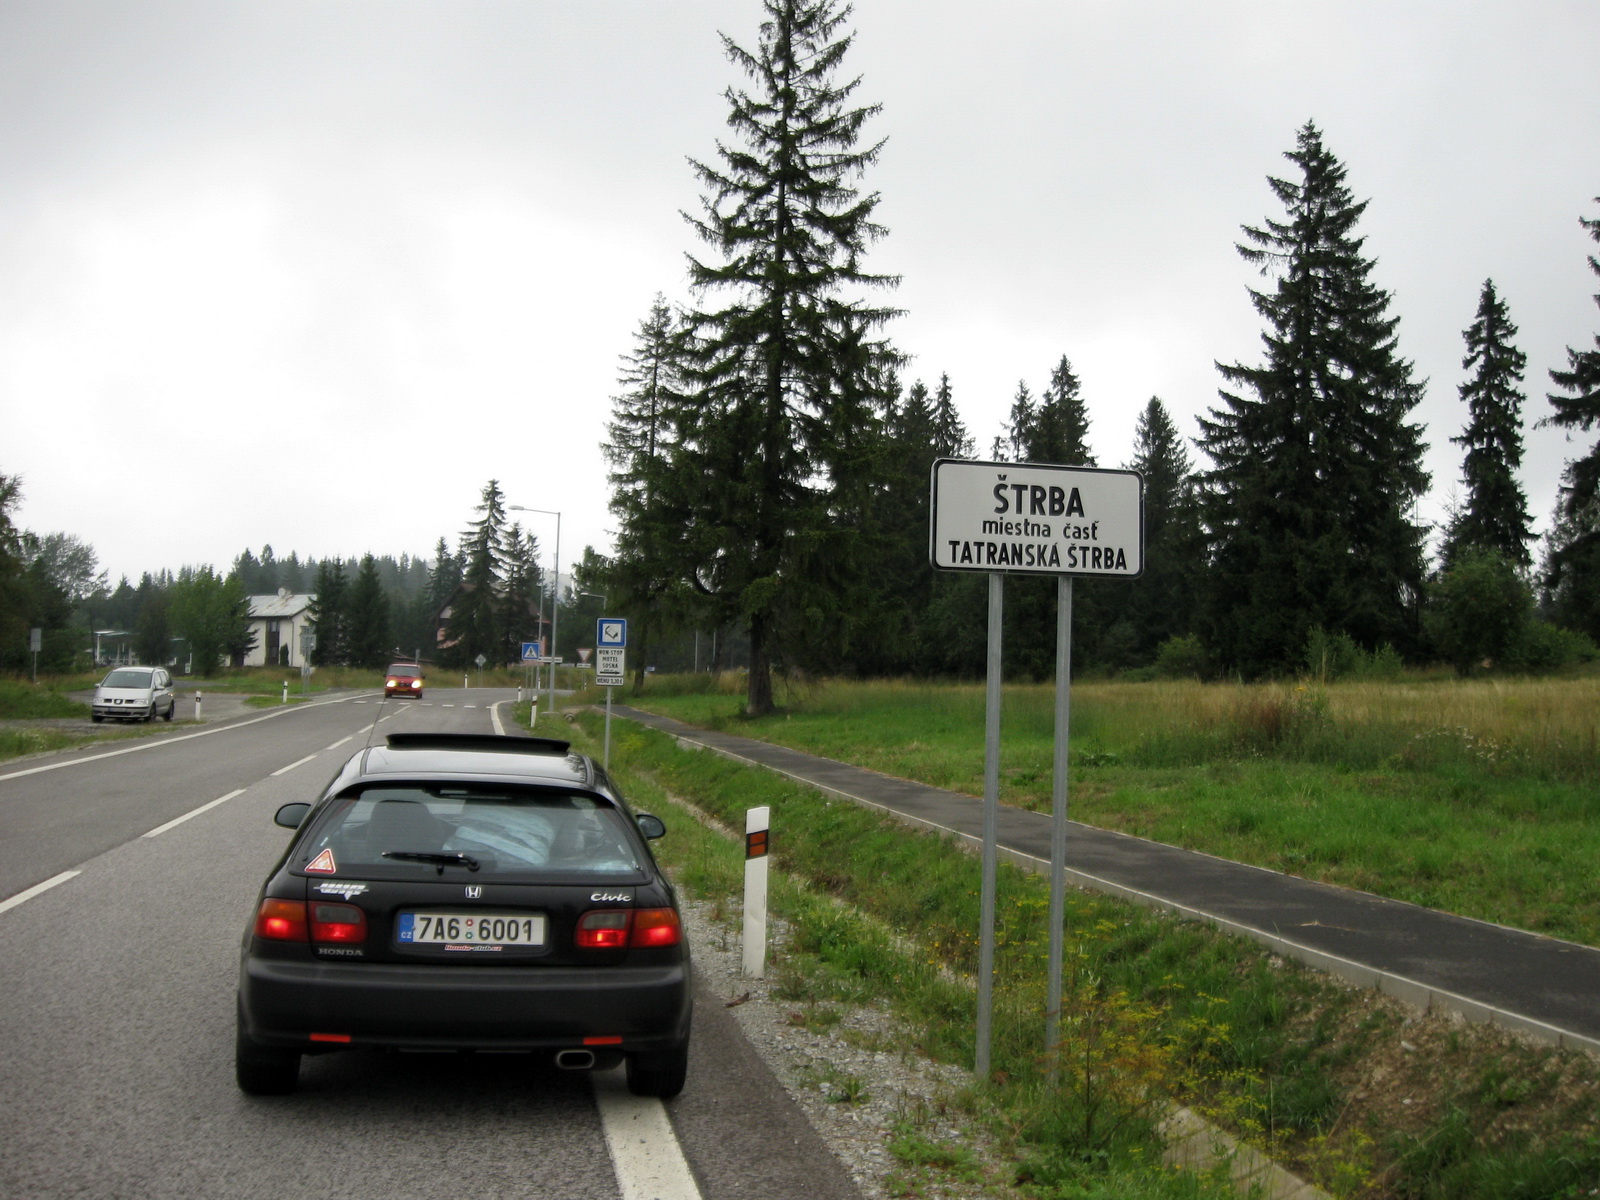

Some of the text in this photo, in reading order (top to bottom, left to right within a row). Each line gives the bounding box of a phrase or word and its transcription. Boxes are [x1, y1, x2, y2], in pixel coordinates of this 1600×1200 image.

[993, 474, 1085, 518] ŠTRBA
[982, 516, 1099, 541] miestna časť
[948, 540, 1128, 571] TATRANSKÁ ŠTRBA
[590, 892, 632, 902] Civic
[401, 917, 532, 942] CZ 7A6 6001
[318, 948, 363, 956] HONDA
